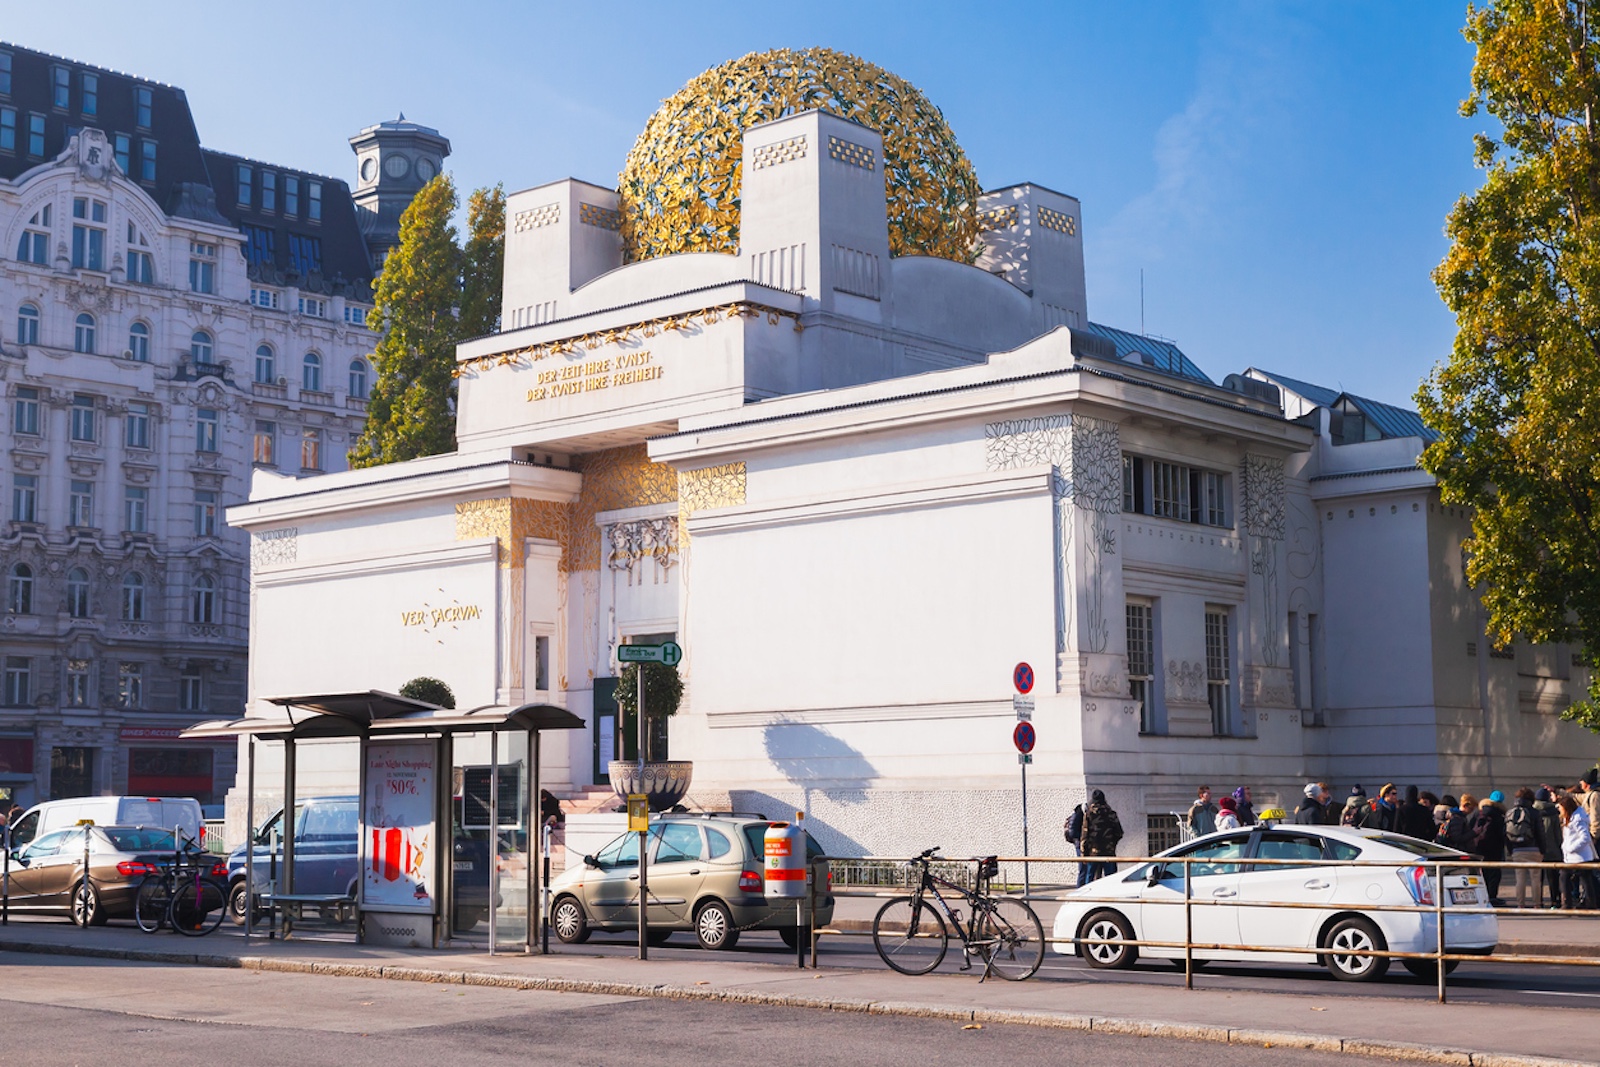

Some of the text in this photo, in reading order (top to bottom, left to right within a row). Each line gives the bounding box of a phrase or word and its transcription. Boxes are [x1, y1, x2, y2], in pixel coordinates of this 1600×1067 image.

[537, 369, 557, 385] DER
[560, 365, 583, 380] ZEIT
[584, 359, 610, 376] IHRE
[525, 386, 546, 403] DER
[584, 375, 609, 392] IHRE
[611, 365, 662, 387] FREIHEIT
[401, 610, 426, 626] VER
[663, 646, 676, 662] H
[120, 729, 144, 737] BIKES
[385, 759, 402, 770] Night
[402, 759, 432, 771] Shopping
[391, 779, 417, 795] 80%
